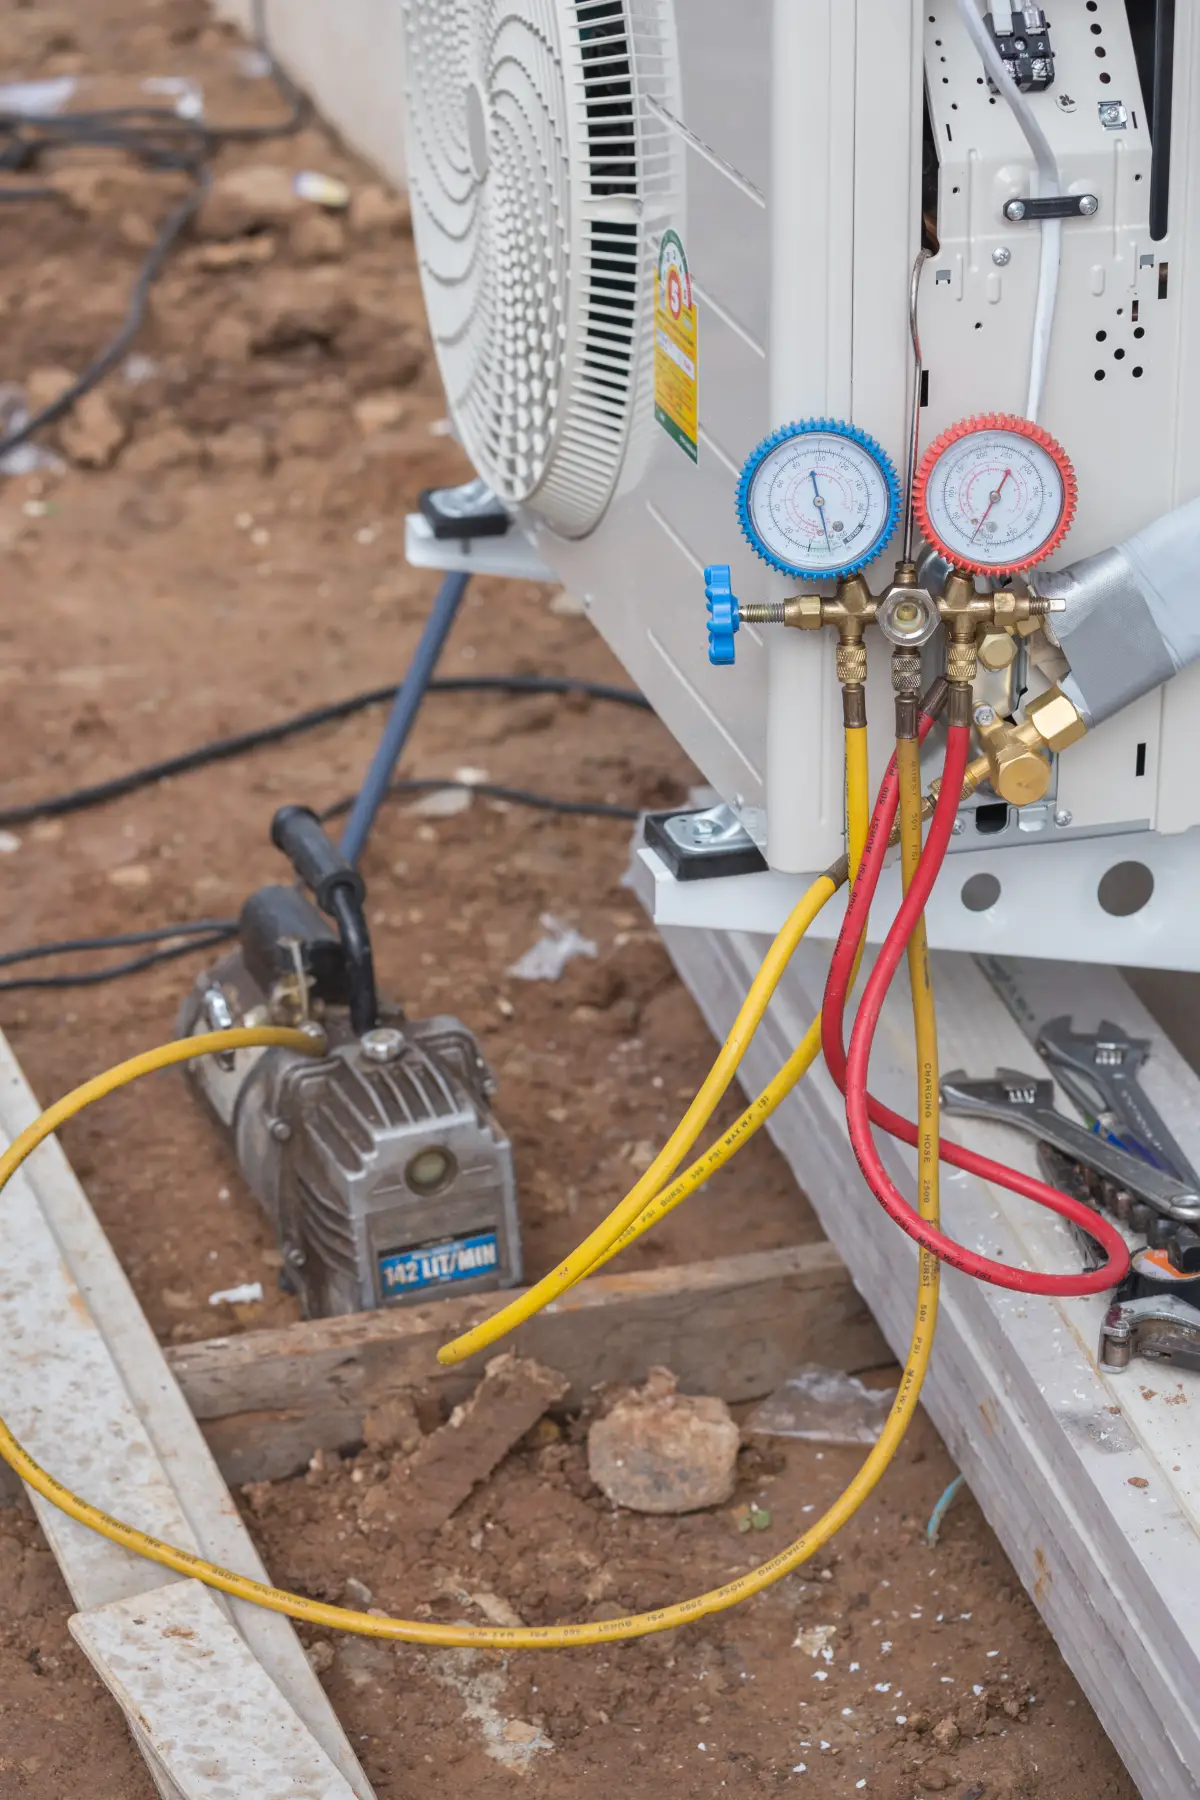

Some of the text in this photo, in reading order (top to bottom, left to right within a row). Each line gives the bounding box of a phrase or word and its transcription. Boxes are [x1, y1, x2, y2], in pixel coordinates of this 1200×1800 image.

[1000, 43, 1006, 52] 1
[1037, 42, 1045, 50] 2
[975, 451, 989, 460] 200
[1000, 451, 1014, 460] 250
[838, 462, 849, 472] 120
[855, 479, 863, 491] 140
[952, 511, 961, 520] 50
[784, 525, 794, 534] 20
[1006, 527, 1018, 538] 450
[847, 891, 858, 916] 2500
[857, 863, 867, 881] PSI
[866, 817, 881, 853] BURST
[880, 787, 889, 804] 500
[923, 1062, 932, 1204] CHARGING HOSE 2500
[660, 1184, 685, 1207] BURST
[708, 1149, 722, 1163] PSI
[893, 1215, 910, 1232] PSI
[384, 1242, 497, 1287] 142 LIT/MIN
[919, 1304, 927, 1322] 500
[913, 1336, 922, 1354] PSI
[757, 1540, 806, 1577] CHARGING
[717, 1581, 745, 1598] HOSE
[647, 1612, 665, 1622] PSI
